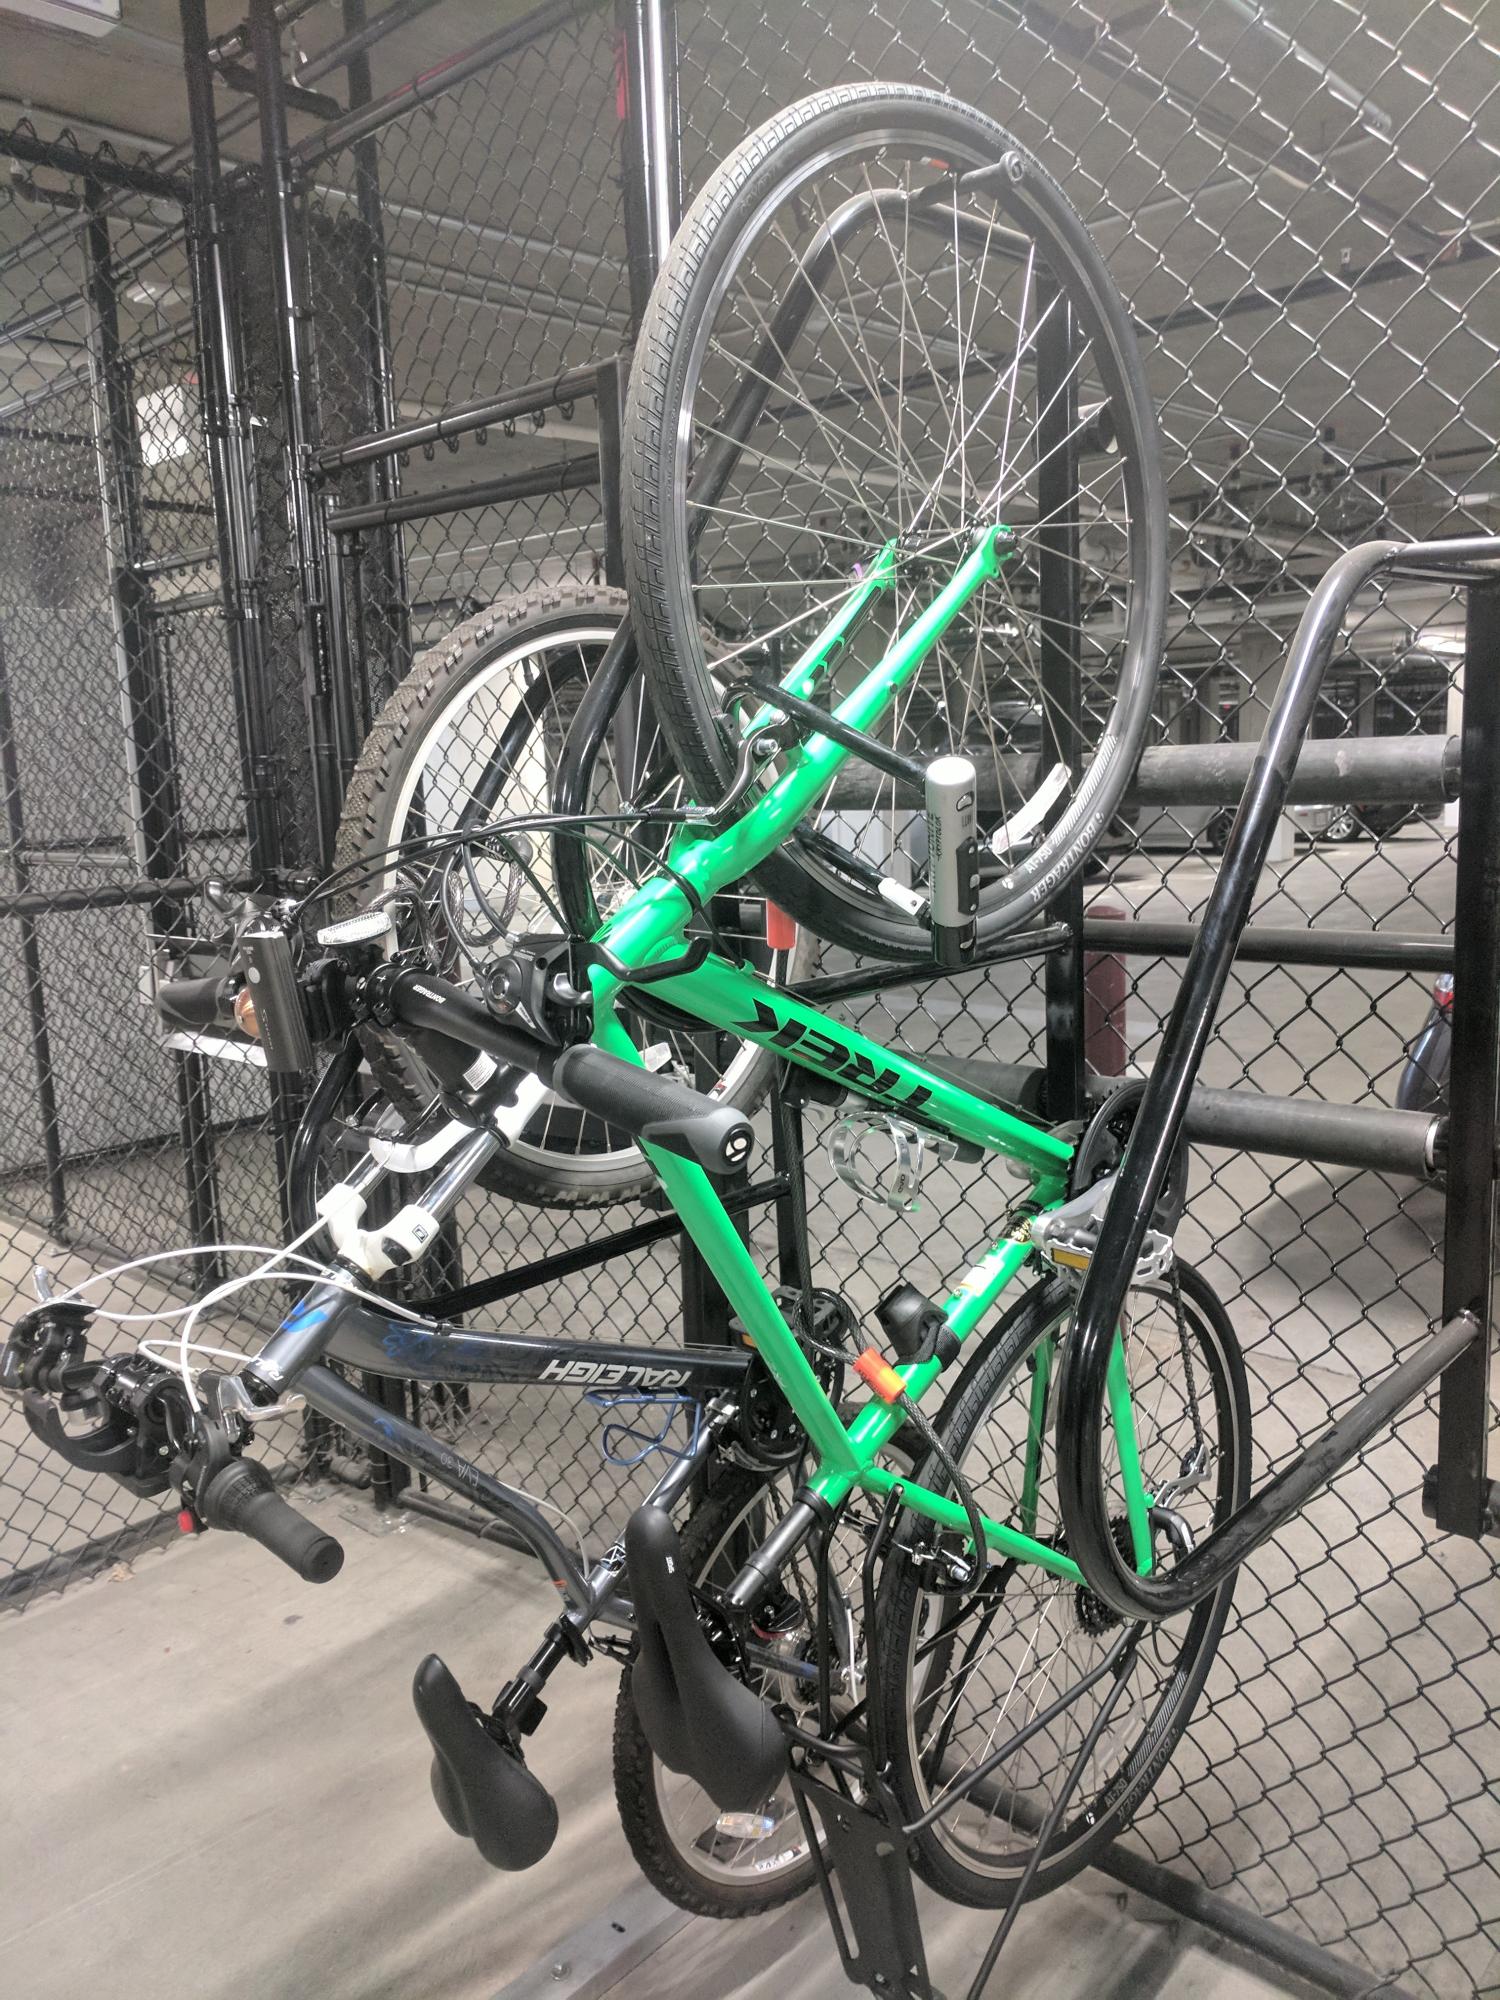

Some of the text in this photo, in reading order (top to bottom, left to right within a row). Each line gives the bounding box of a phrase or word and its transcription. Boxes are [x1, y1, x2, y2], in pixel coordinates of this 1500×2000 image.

[1030, 820, 1097, 903] BONTRAGER
[412, 984, 447, 1005] BONTRAGER
[731, 998, 933, 1117] TREK
[538, 1359, 693, 1388] RALEIGH
[1117, 1736, 1172, 1820] BONTRAGER
